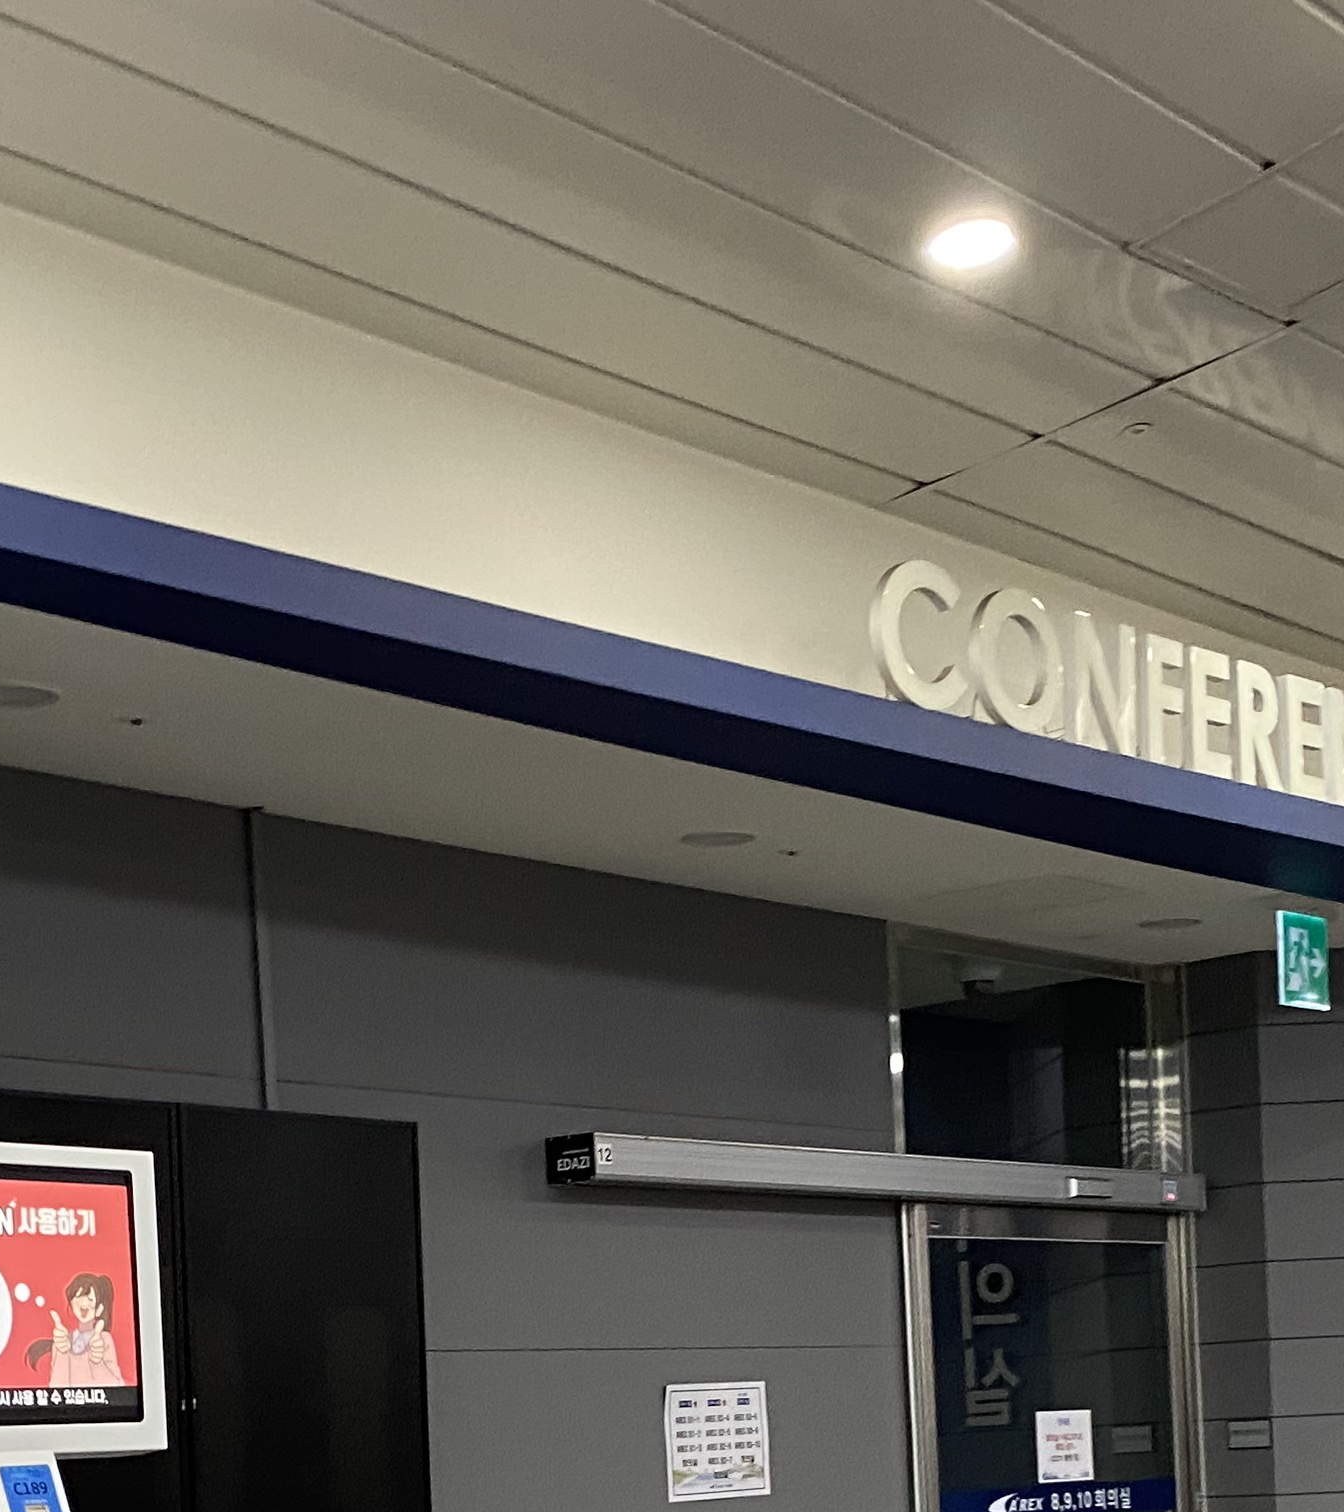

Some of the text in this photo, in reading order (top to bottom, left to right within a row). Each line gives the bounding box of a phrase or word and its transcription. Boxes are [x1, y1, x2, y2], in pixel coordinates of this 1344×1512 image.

[598, 1147, 613, 1162] 12
[18, 1206, 97, 1236] 사용하기
[12, 1389, 34, 1406] 사용
[50, 1389, 62, 1405] 수
[63, 1388, 109, 1405] 있습니다.
[13, 1481, 49, 1495] C189
[1094, 1487, 1132, 1510] 회의실
